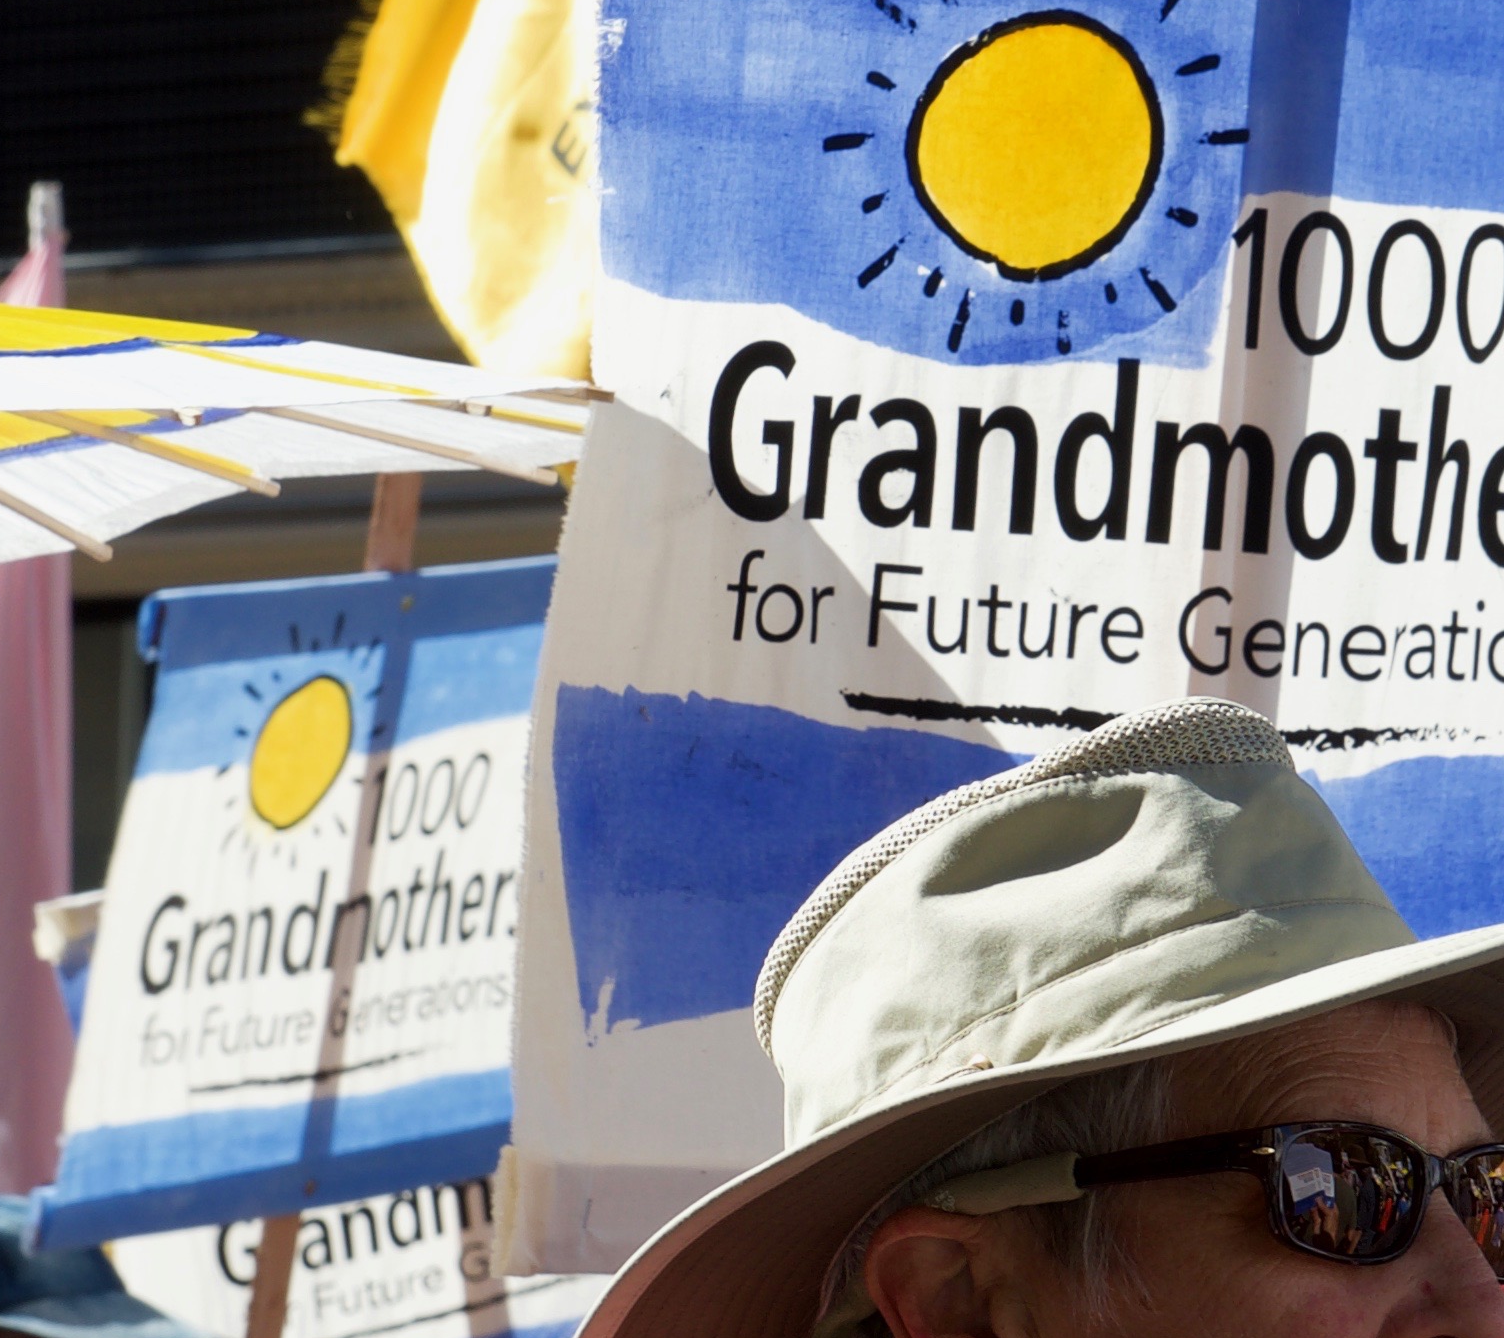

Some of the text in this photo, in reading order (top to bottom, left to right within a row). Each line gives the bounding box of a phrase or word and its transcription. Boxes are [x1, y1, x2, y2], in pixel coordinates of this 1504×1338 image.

[727, 552, 840, 645] for
[867, 562, 1145, 666] Future
[369, 752, 492, 845] 1000
[141, 866, 518, 996] Grandmother
[199, 992, 315, 1059] Future
[310, 1265, 446, 1321] Future
